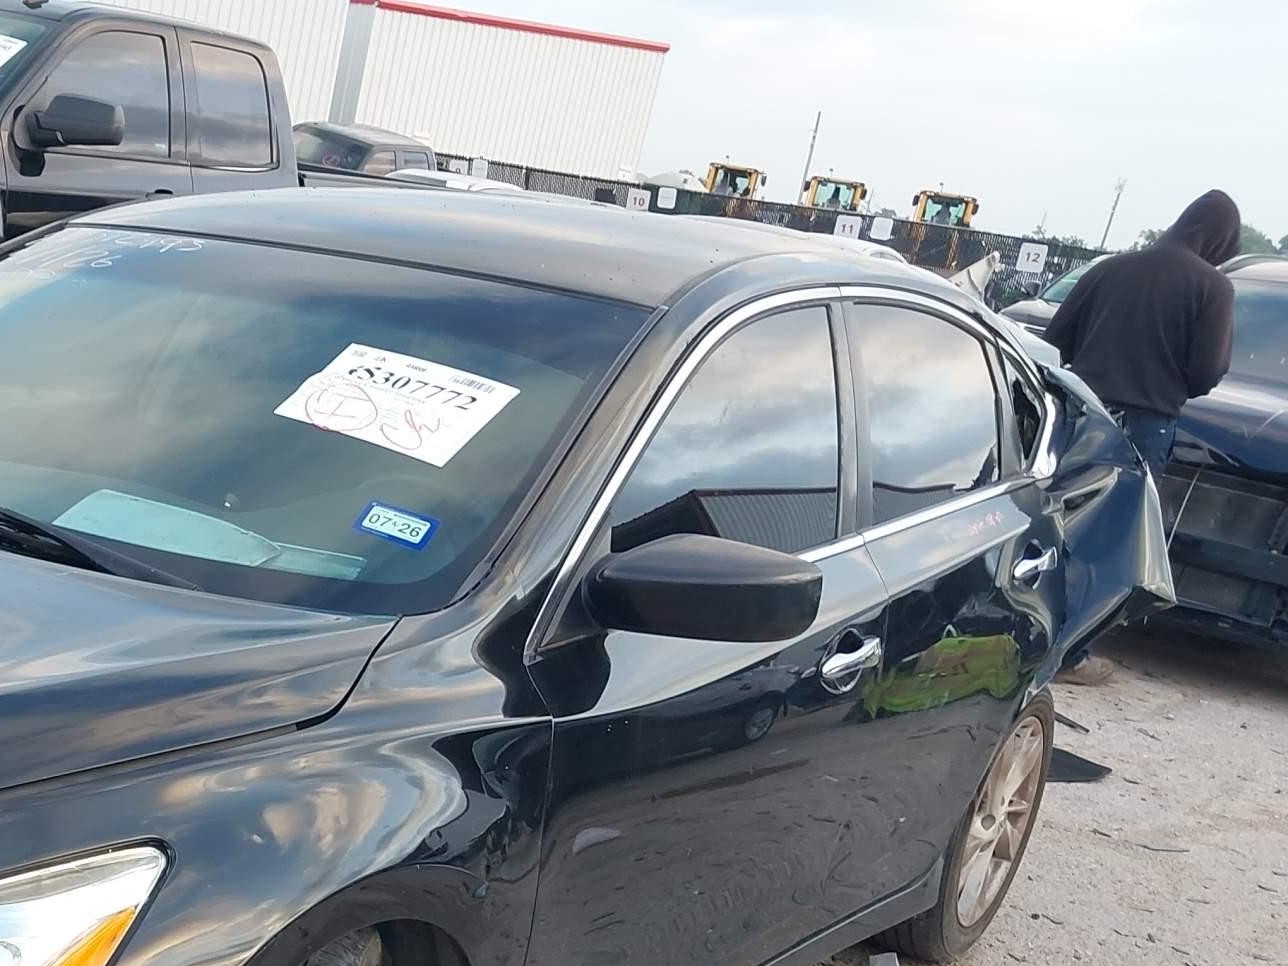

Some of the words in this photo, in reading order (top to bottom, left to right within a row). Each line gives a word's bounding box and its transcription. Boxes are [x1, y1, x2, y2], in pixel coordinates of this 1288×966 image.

[632, 196, 645, 207] 10
[841, 223, 854, 234] 11
[1025, 251, 1041, 264] 12
[368, 513, 392, 527] 07
[397, 522, 422, 538] 26
